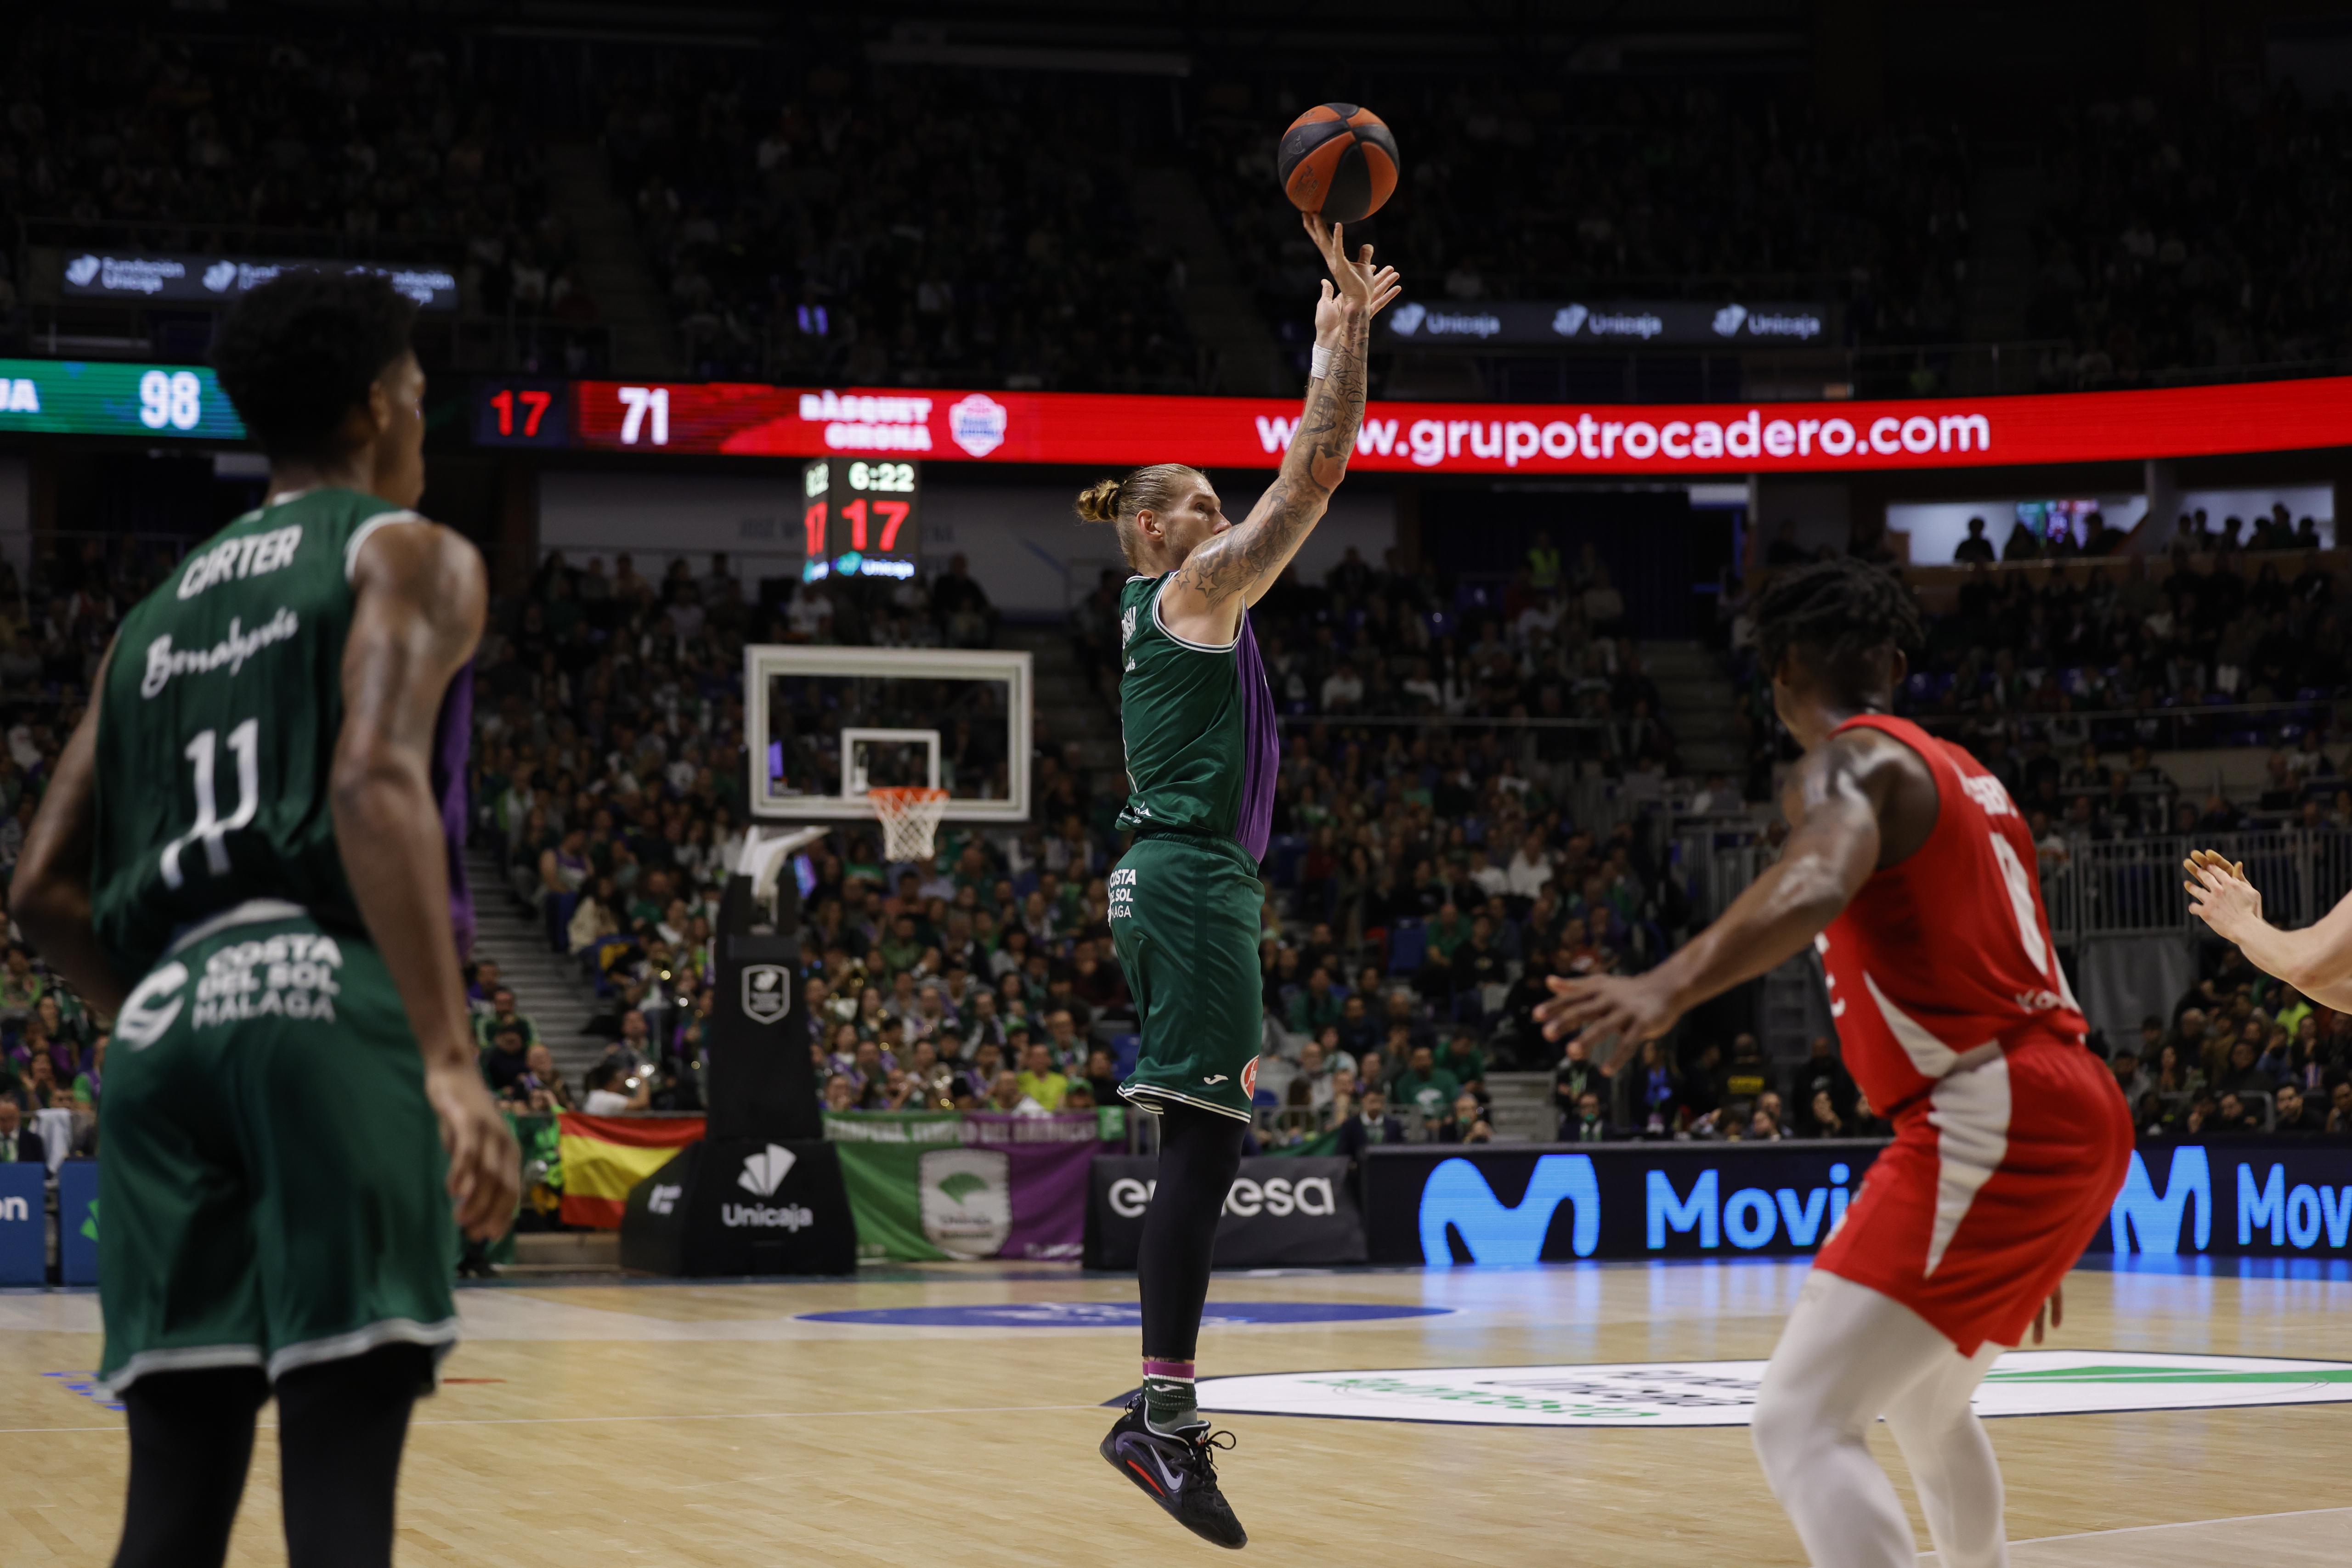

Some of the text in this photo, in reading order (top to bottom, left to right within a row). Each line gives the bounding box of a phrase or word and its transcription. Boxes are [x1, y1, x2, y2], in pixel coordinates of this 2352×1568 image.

[1426, 314, 1501, 338] Unicaja
[1589, 314, 1662, 339] Unicaja
[1748, 314, 1820, 339] Unicaja
[140, 370, 201, 430] 98
[491, 390, 550, 437] 17
[618, 387, 669, 446] 71
[1255, 410, 1990, 467] ww.grupotrocadero.com
[848, 461, 915, 492] 6:22
[841, 497, 910, 551] 17
[176, 523, 303, 601] CARTER
[1109, 869, 1136, 889] COSTA
[1115, 888, 1134, 902] SOL
[205, 933, 344, 978] COSTA
[196, 962, 341, 1001] DEL SOL
[722, 1202, 814, 1233] Unicaja
[1108, 1177, 1336, 1218] eesa
[2237, 1162, 2352, 1250] Mov
